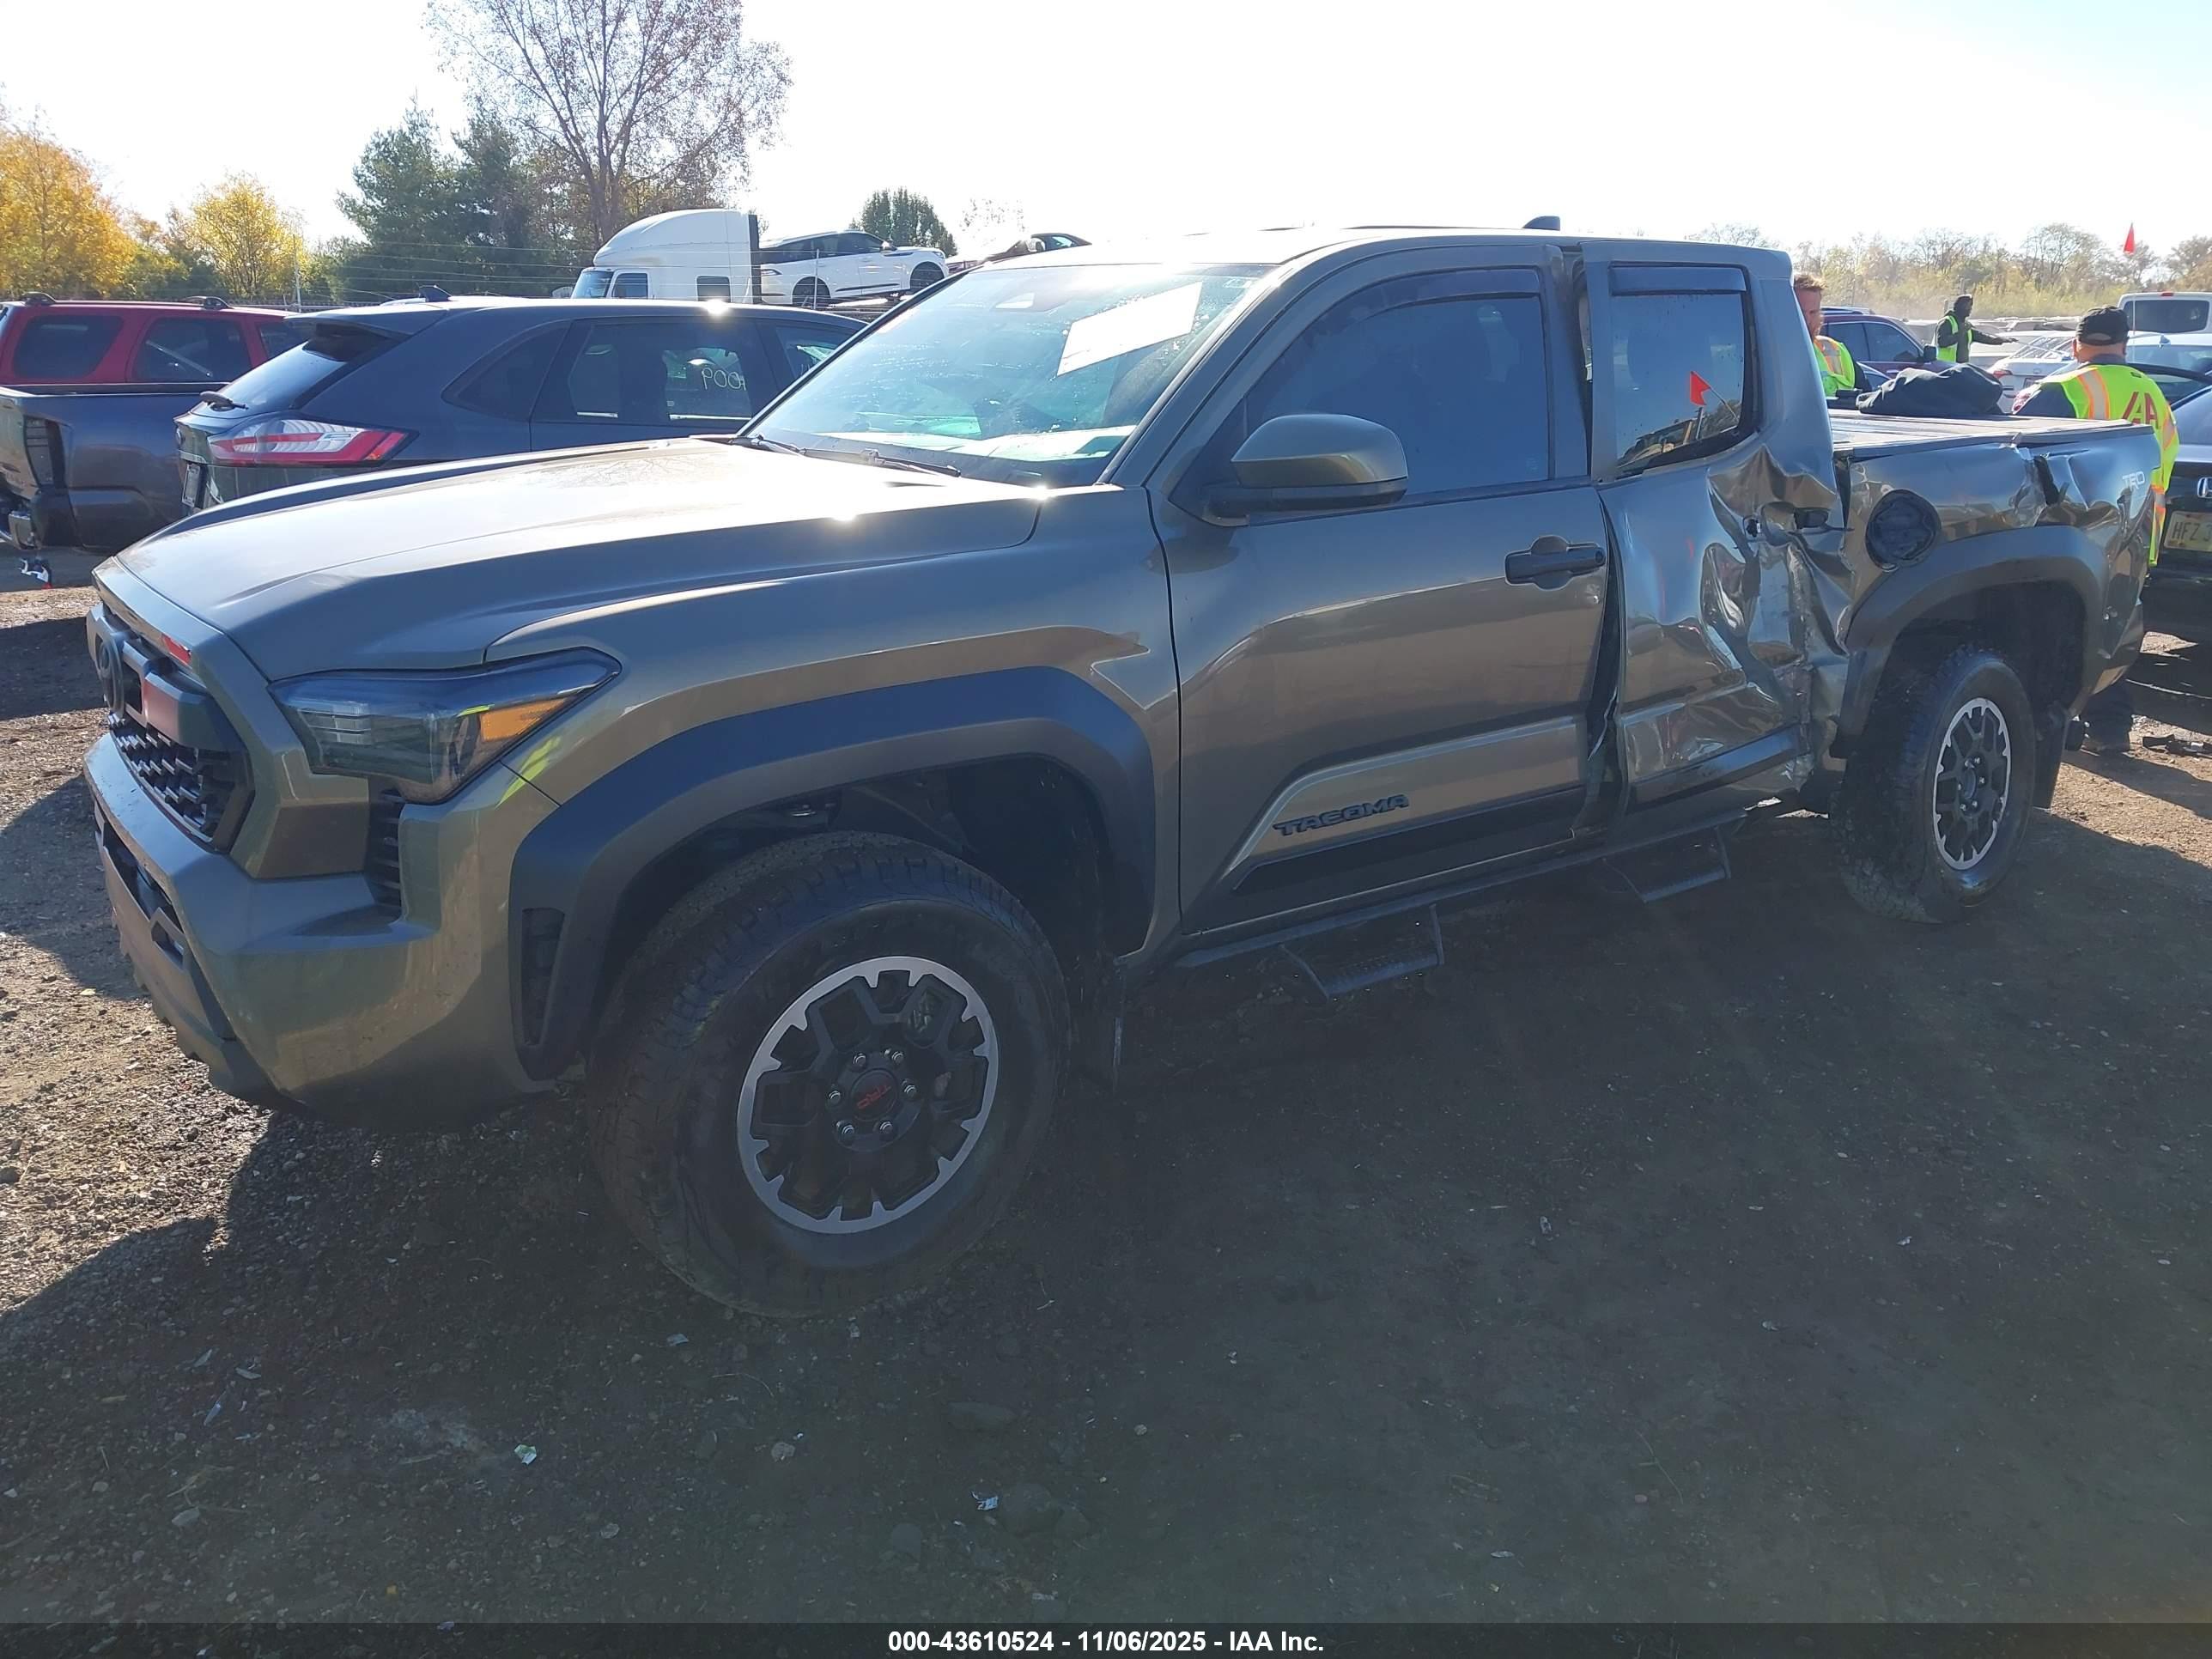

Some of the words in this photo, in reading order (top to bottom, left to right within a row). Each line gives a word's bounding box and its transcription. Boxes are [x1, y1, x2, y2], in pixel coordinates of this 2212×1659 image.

[2122, 471, 2146, 492] TRD
[2172, 521, 2201, 542] HFZ
[1273, 793, 1410, 836] TACOMA
